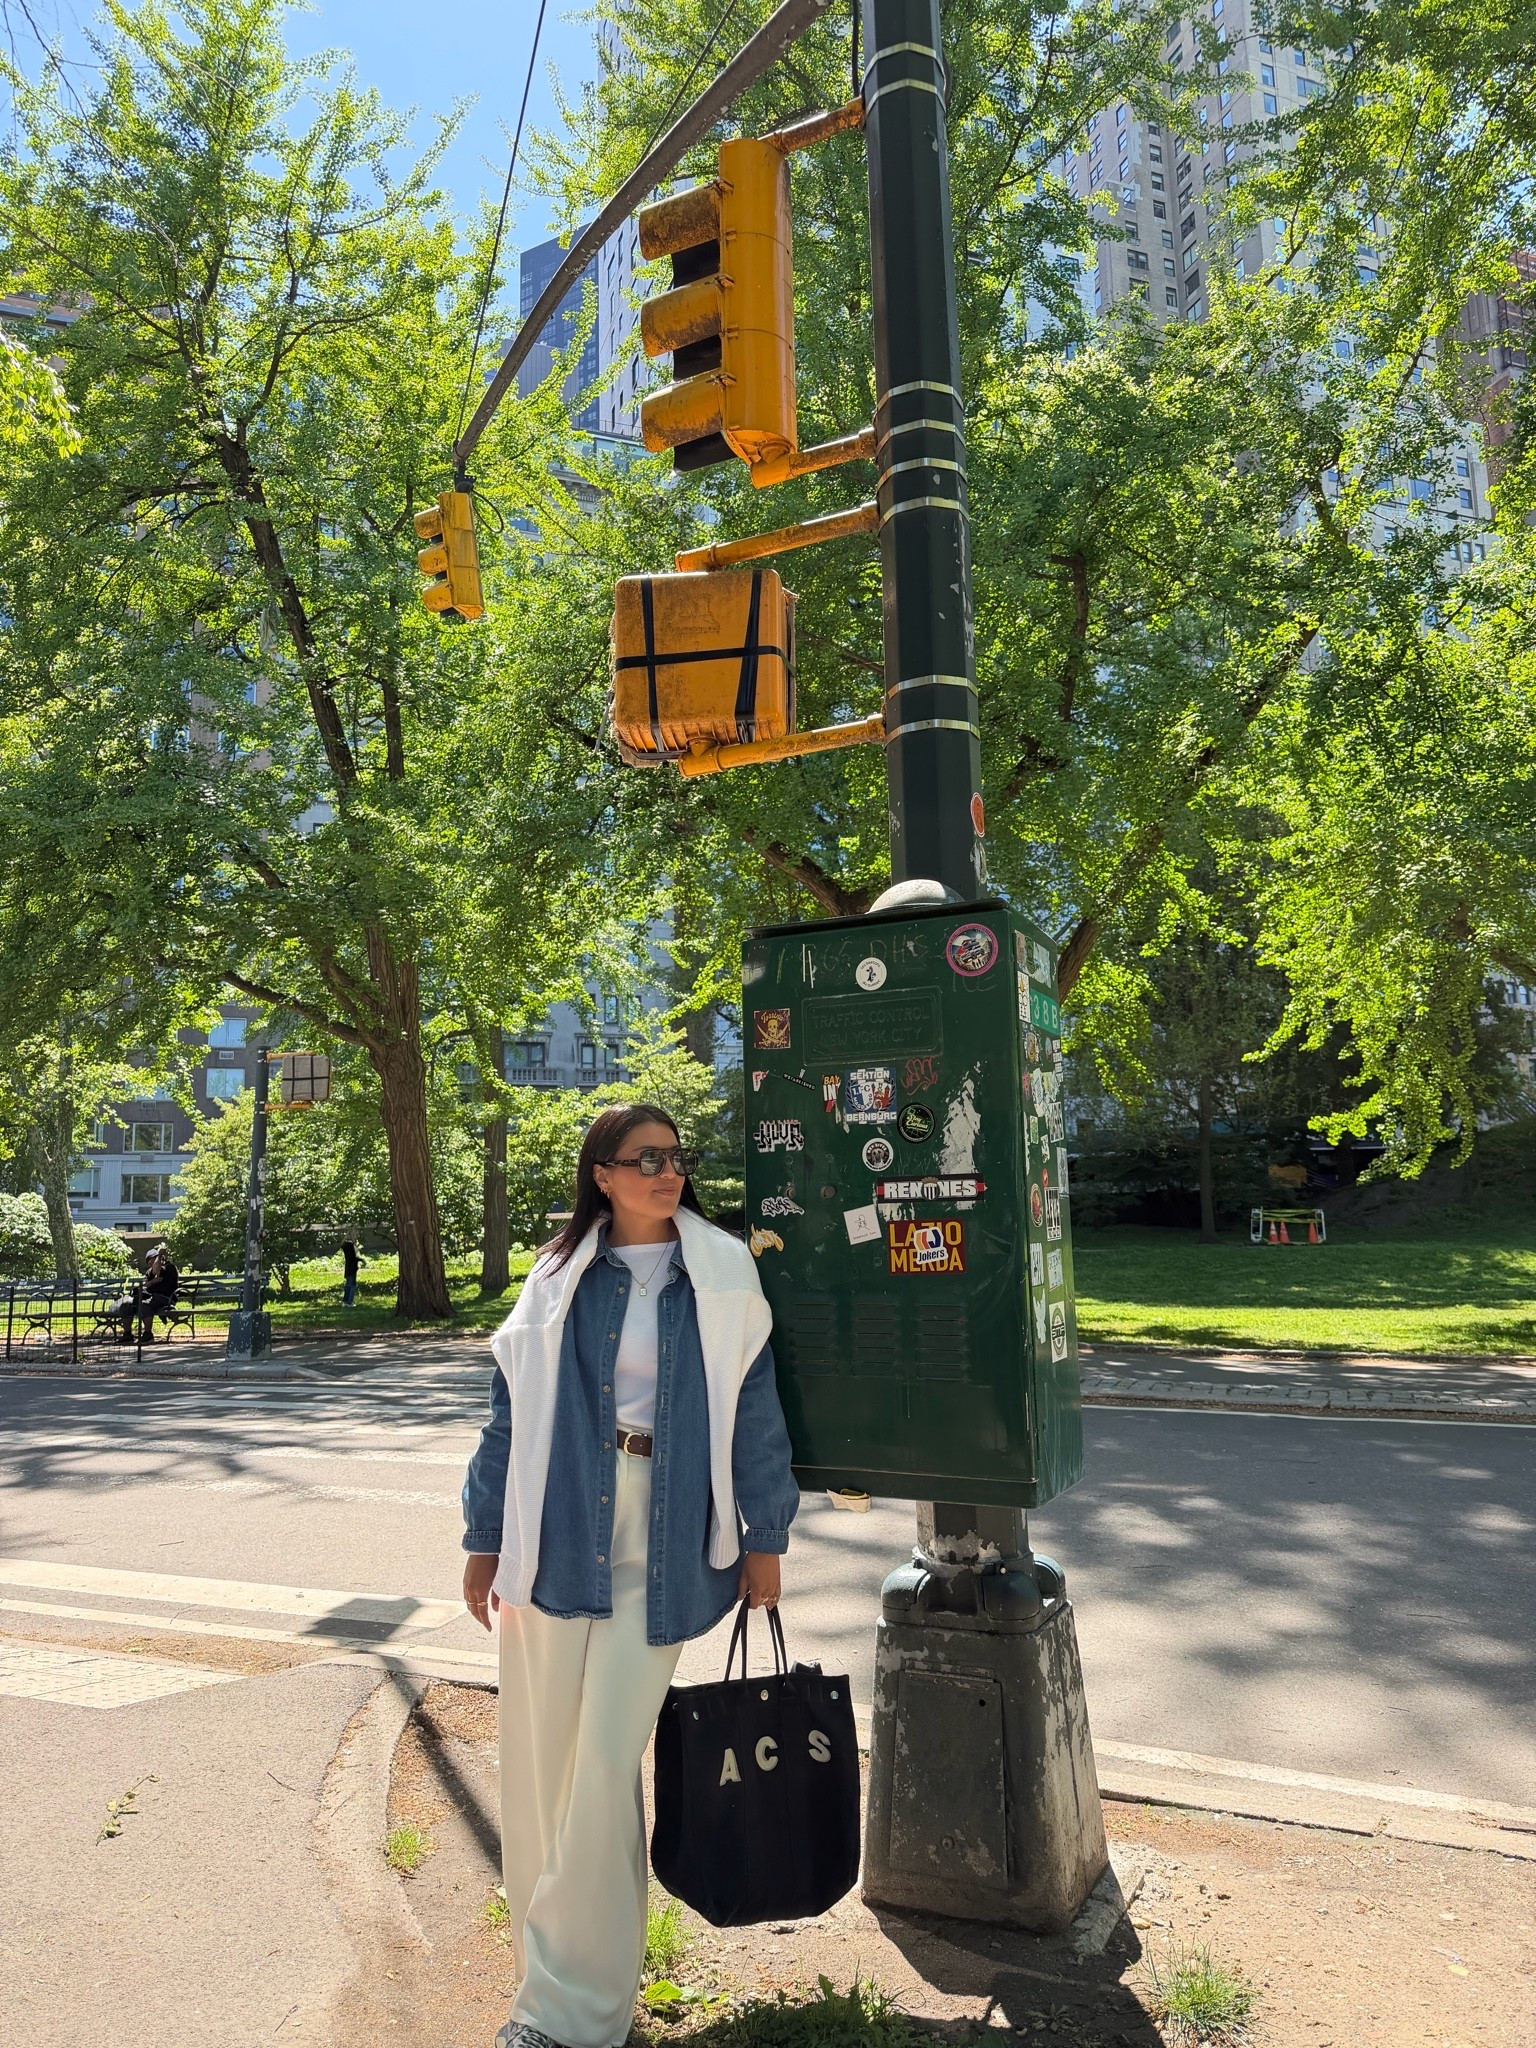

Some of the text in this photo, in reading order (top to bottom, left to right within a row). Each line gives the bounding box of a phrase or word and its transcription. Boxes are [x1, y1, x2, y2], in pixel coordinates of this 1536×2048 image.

[812, 1005, 930, 1029] TRAFFIC CONTROL
[819, 1026, 922, 1047] NEW YORK CITY
[850, 1070, 890, 1081] SEKTION
[846, 1111, 897, 1122] BERNBURG
[884, 1179, 978, 1200] RENNES
[889, 1220, 962, 1248] LAO
